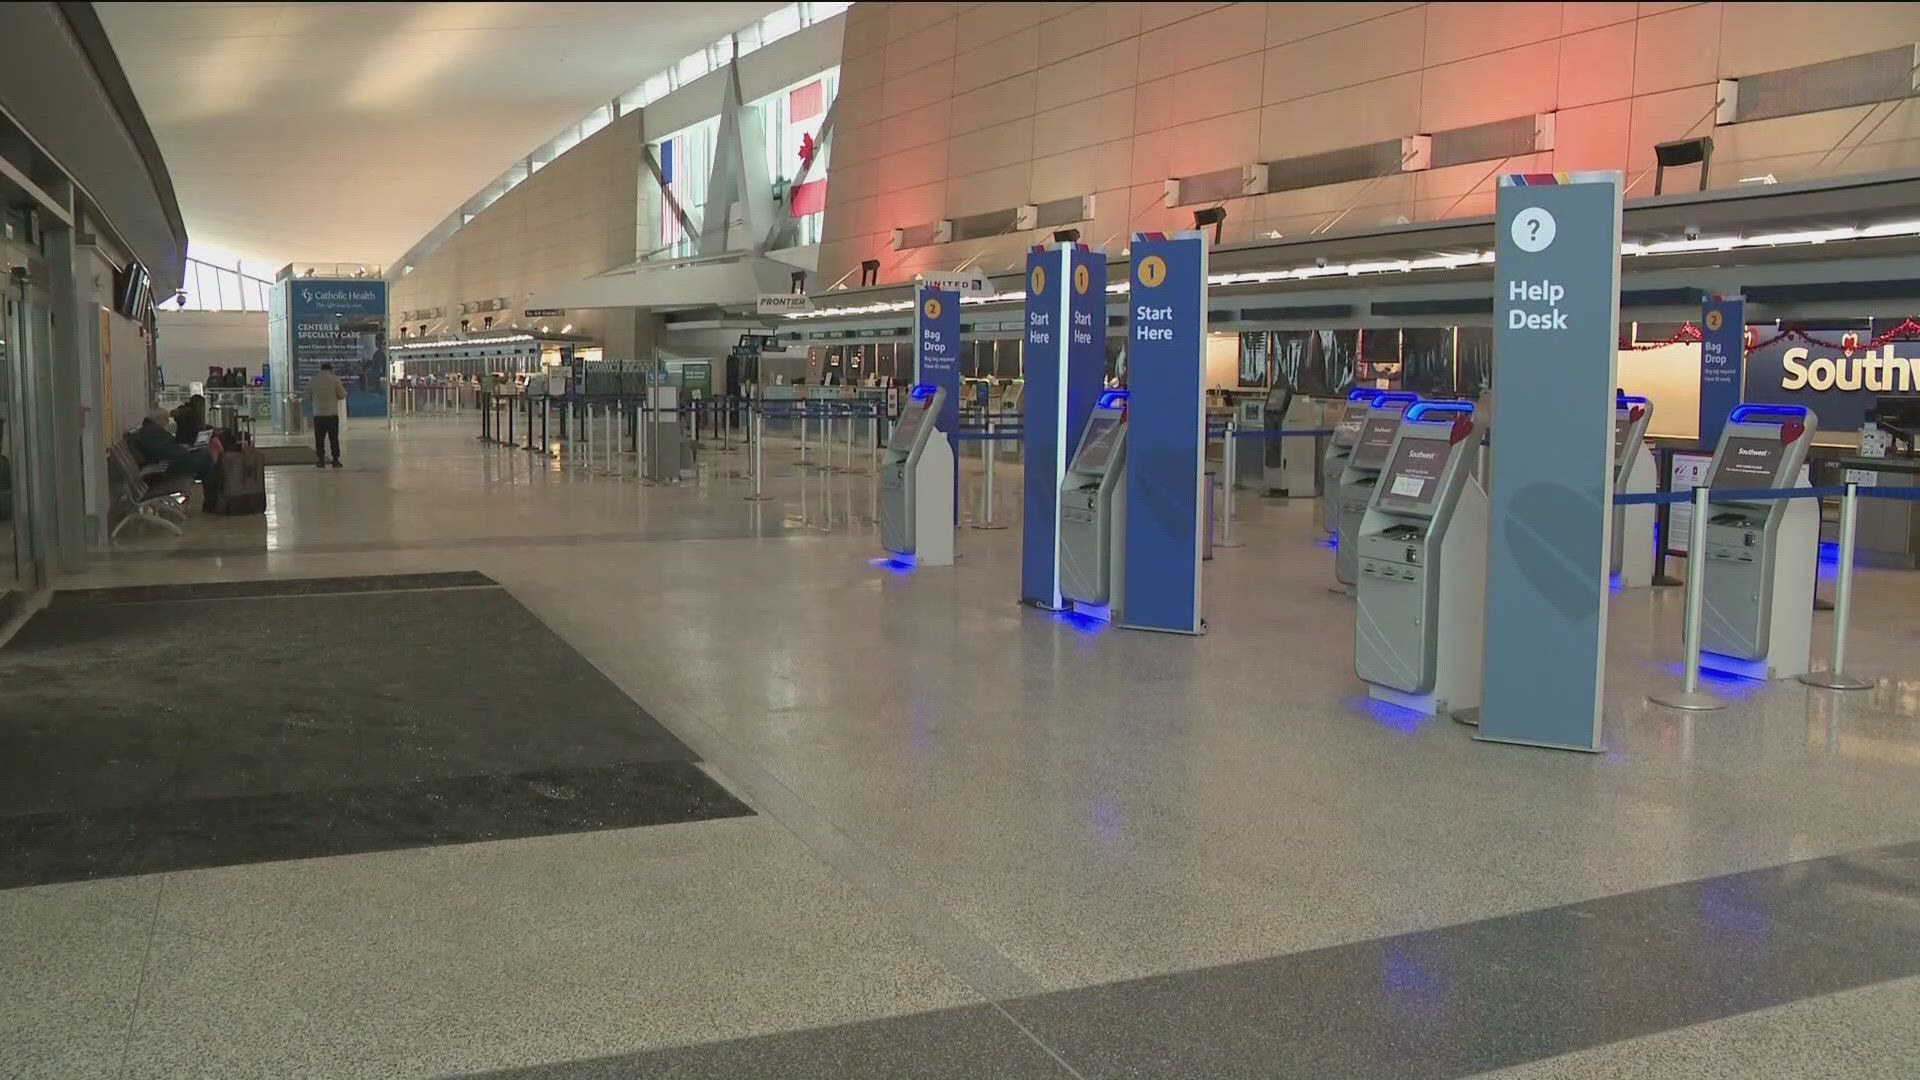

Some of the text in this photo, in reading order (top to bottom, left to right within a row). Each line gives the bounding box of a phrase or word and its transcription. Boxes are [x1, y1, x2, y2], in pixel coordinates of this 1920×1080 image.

[1526, 218, 1541, 241] ?
[314, 290, 376, 300] Catholic Health
[1509, 279, 1565, 306] Help
[760, 298, 806, 306] FRONTIER
[1030, 311, 1049, 326] Start
[1074, 310, 1092, 326] Start
[1136, 305, 1173, 321] Start
[1508, 308, 1569, 330] Desk
[298, 331, 361, 339] SPECIALTY CARE
[924, 329, 941, 341] Bag
[1030, 329, 1050, 344] Here
[1074, 329, 1092, 344] Here
[1136, 326, 1173, 340] Here
[924, 341, 946, 354] Drop
[1705, 341, 1722, 354] Bag
[1705, 354, 1727, 366] Drop
[1408, 449, 1435, 459] Southwest
[1737, 447, 1768, 457] Southwest
